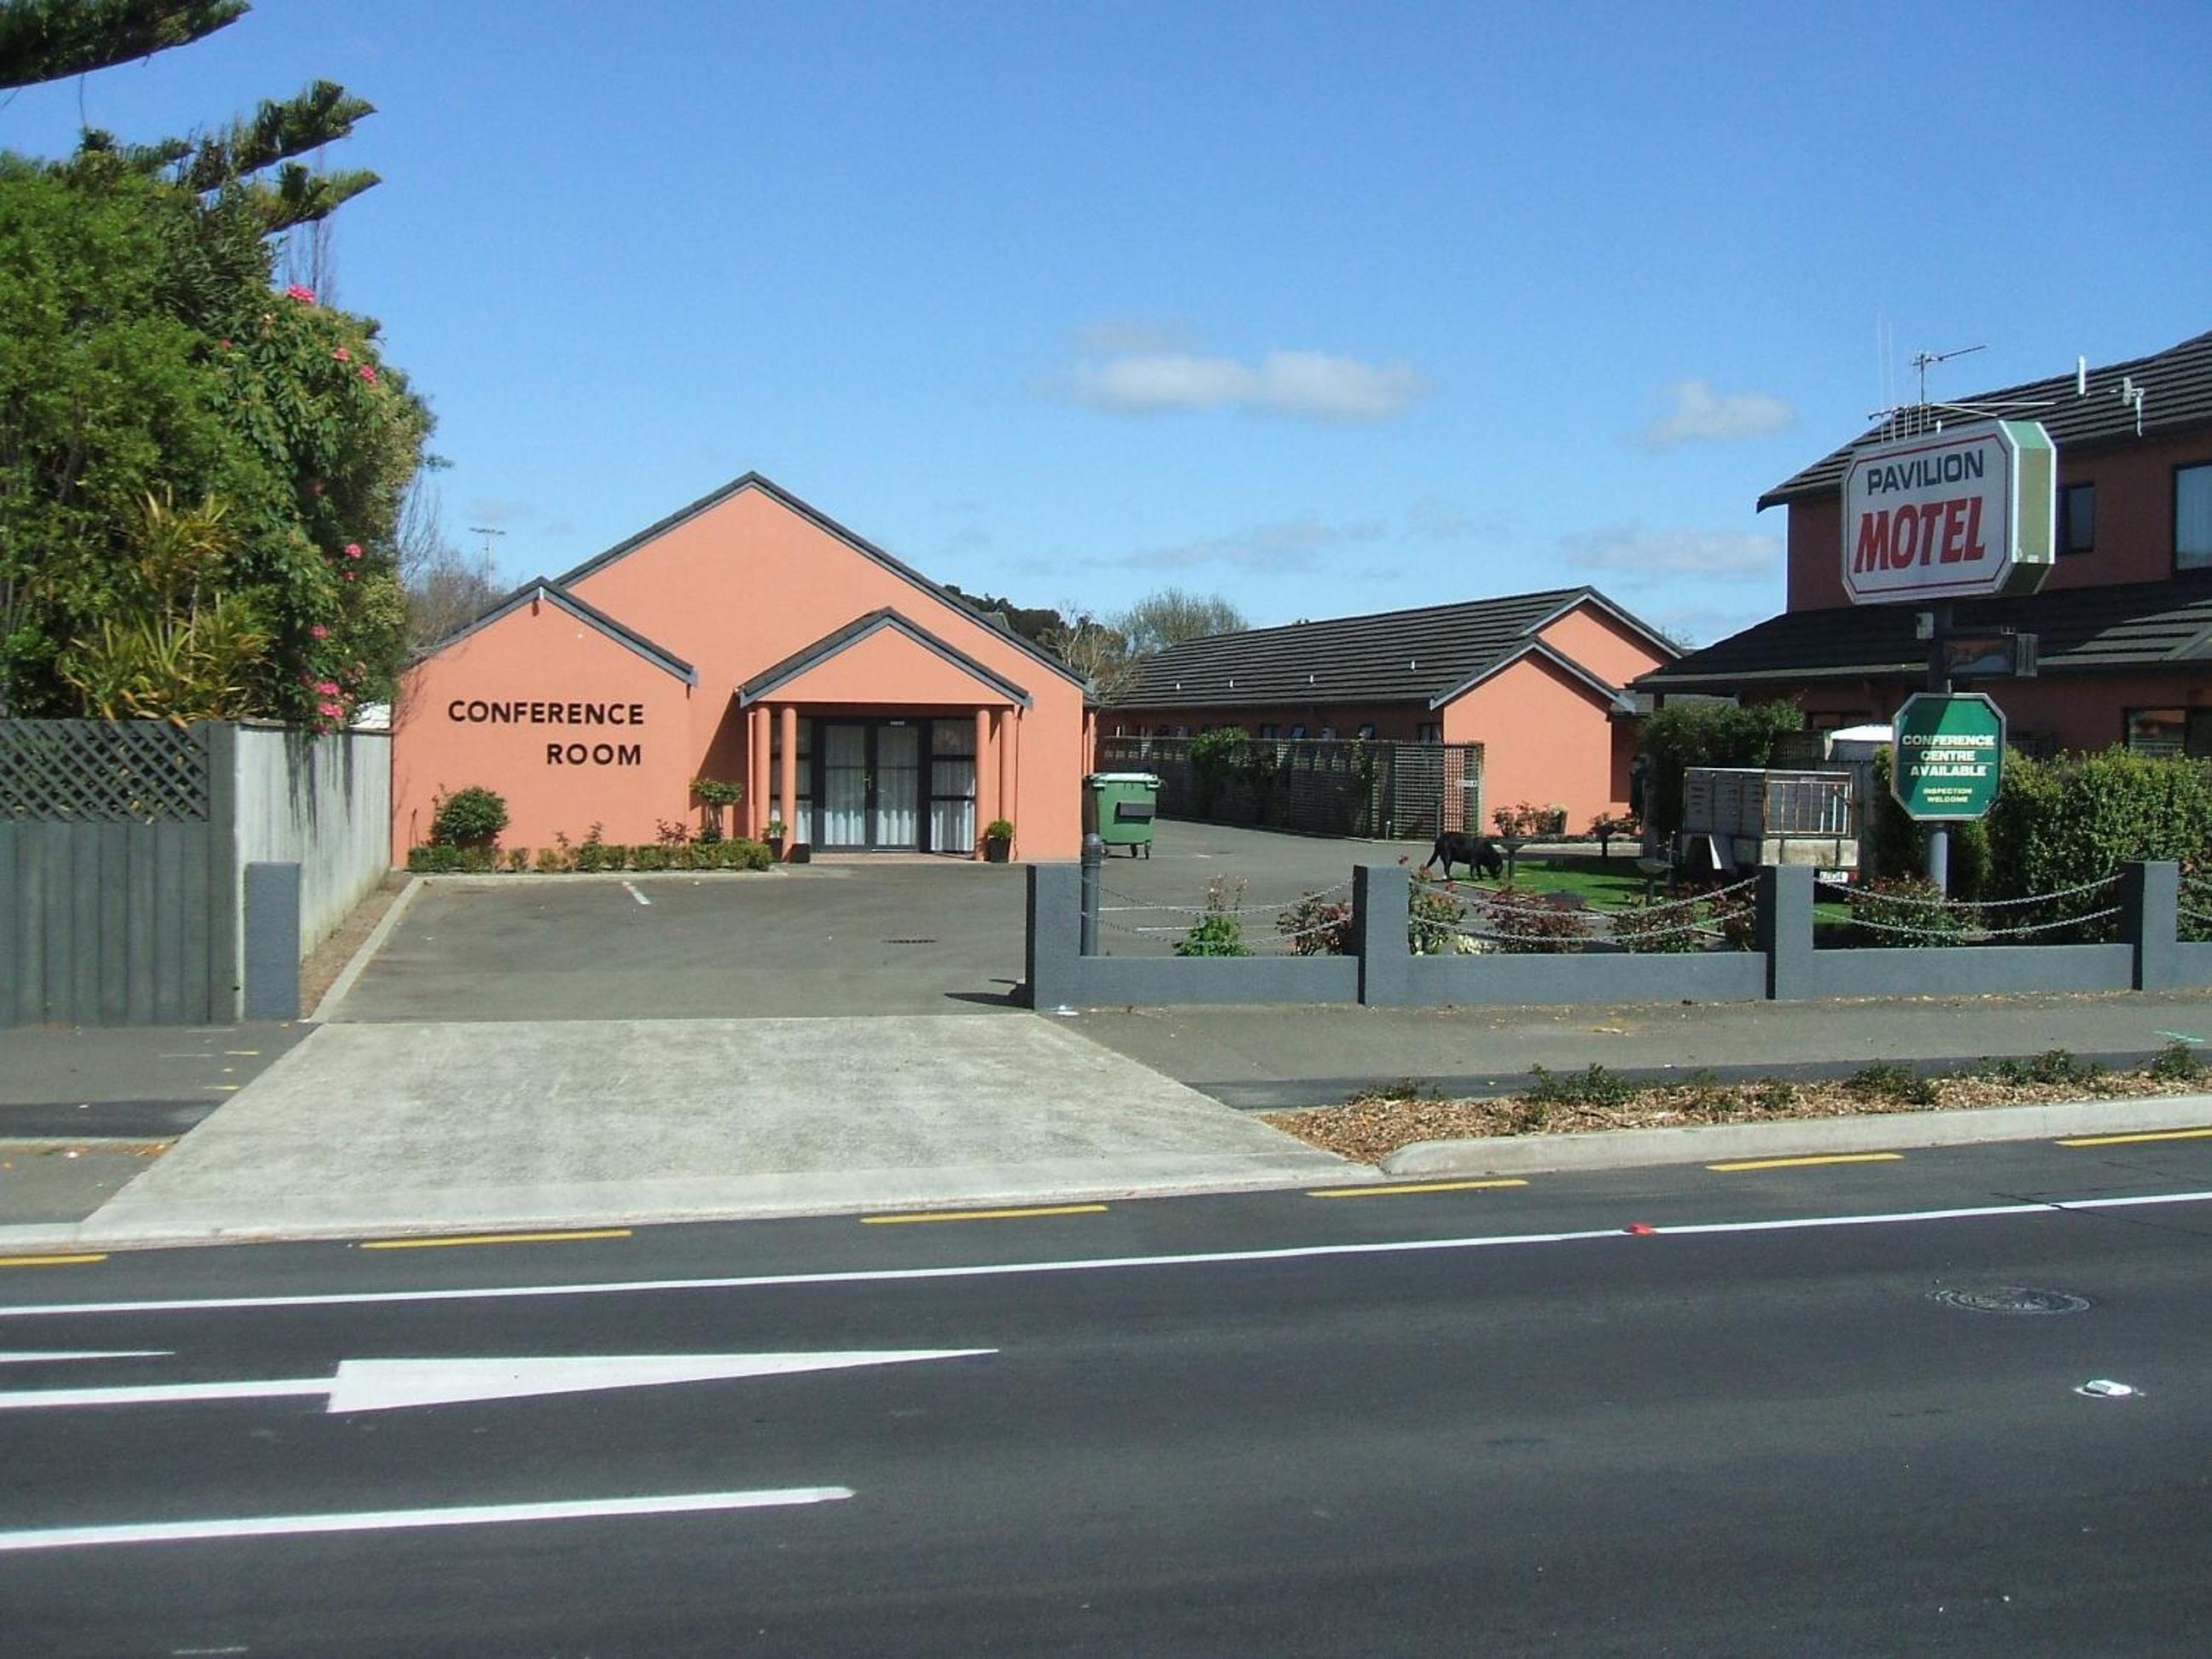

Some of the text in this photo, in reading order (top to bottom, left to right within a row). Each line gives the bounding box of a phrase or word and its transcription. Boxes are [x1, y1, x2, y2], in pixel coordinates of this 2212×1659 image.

[1867, 449, 1983, 495] PAVILION
[1854, 496, 1985, 573] MOTEL
[448, 700, 644, 725] CONFERENCE
[1902, 735, 1994, 746] CONFERENCE
[546, 743, 641, 765] ROOM
[1921, 750, 1976, 762] CENTRE
[1910, 765, 1987, 777] AVAILABLE
